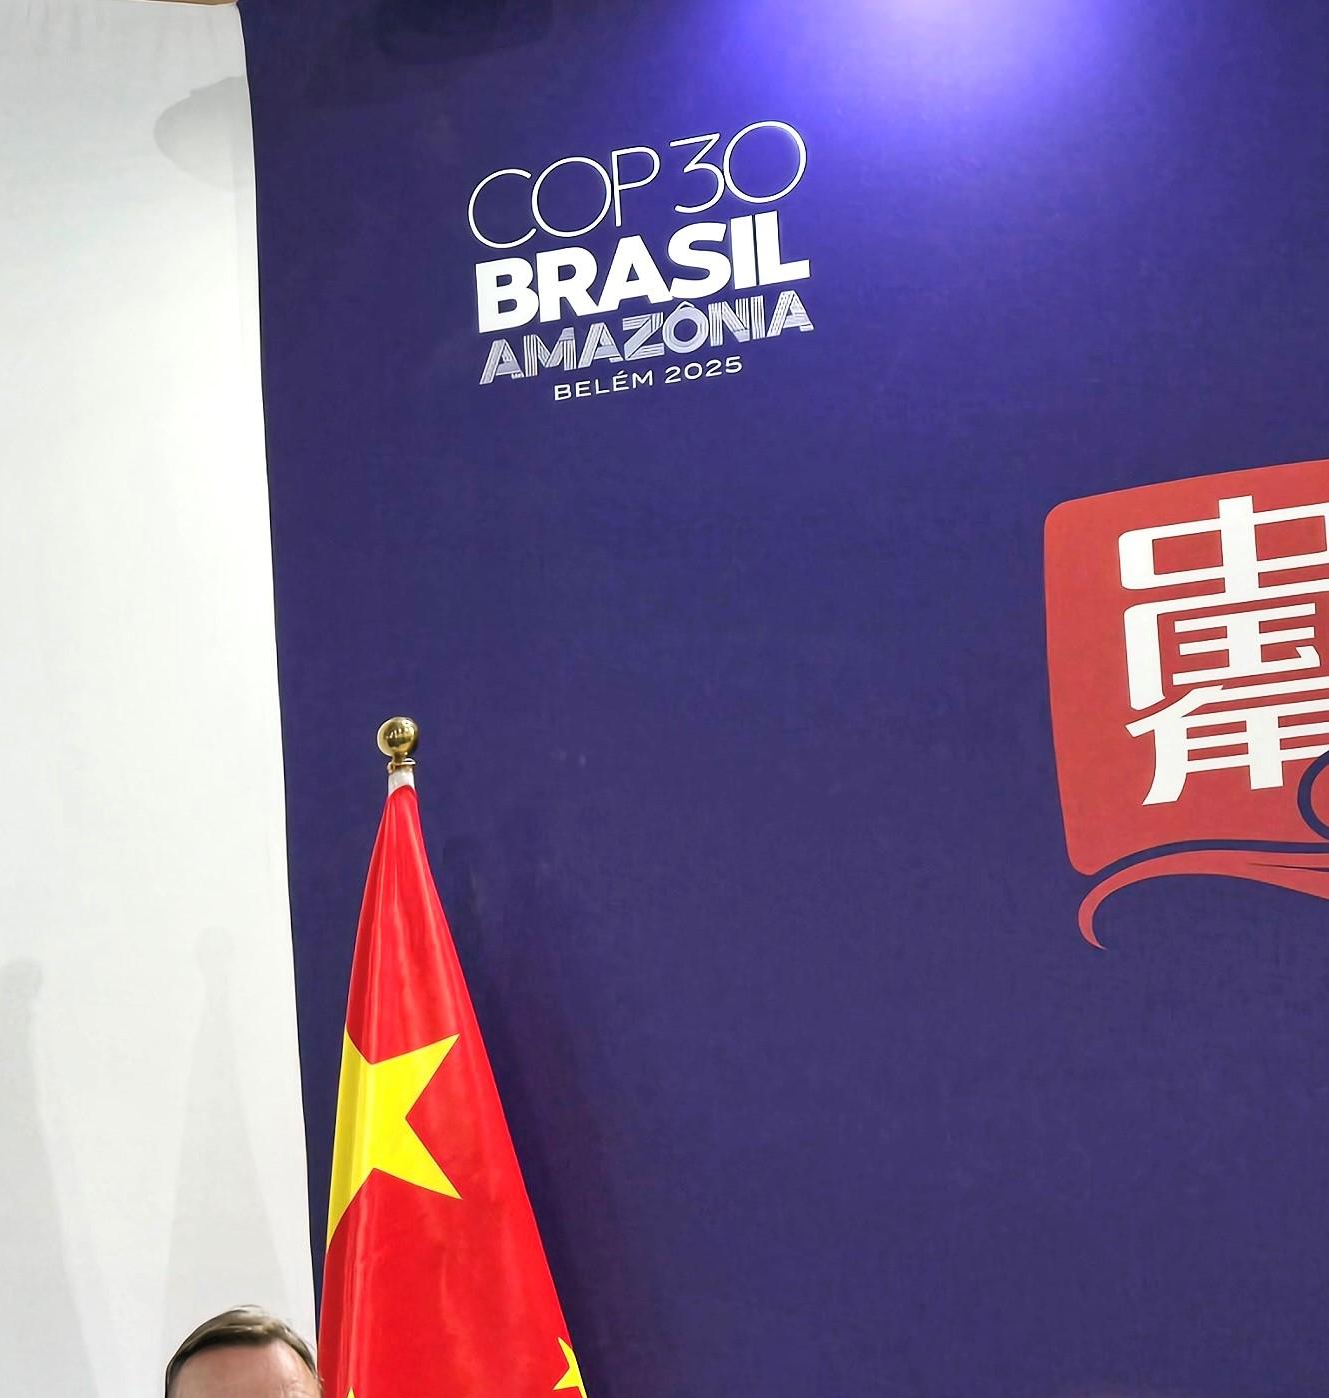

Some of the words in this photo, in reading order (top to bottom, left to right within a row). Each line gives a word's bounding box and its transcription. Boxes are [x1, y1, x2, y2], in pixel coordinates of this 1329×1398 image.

[475, 210, 811, 334] BRASIL
[479, 290, 815, 385] AMAZÔNIA
[554, 370, 654, 400] BELÉM
[665, 356, 743, 384] 2025
